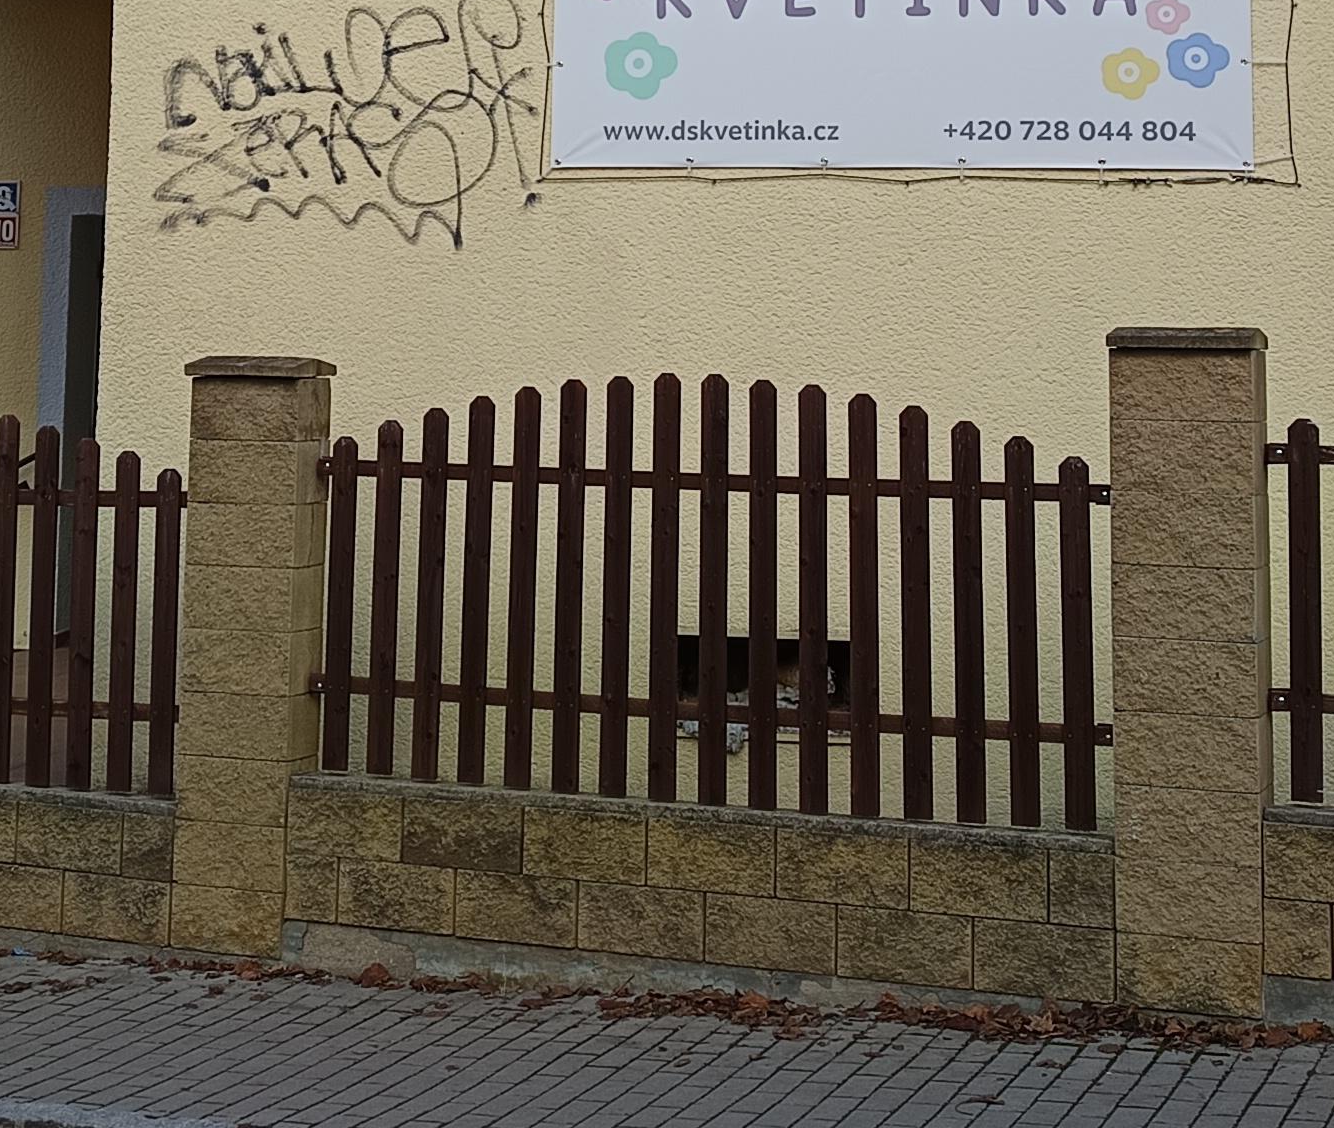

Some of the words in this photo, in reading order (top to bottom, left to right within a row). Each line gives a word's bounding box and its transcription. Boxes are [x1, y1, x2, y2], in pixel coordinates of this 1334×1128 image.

[603, 119, 840, 143] www.dskvetinka.cz
[943, 120, 1012, 143] +420
[1019, 120, 1069, 143] 728
[1078, 120, 1133, 143] 044
[1141, 120, 1197, 143] 804
